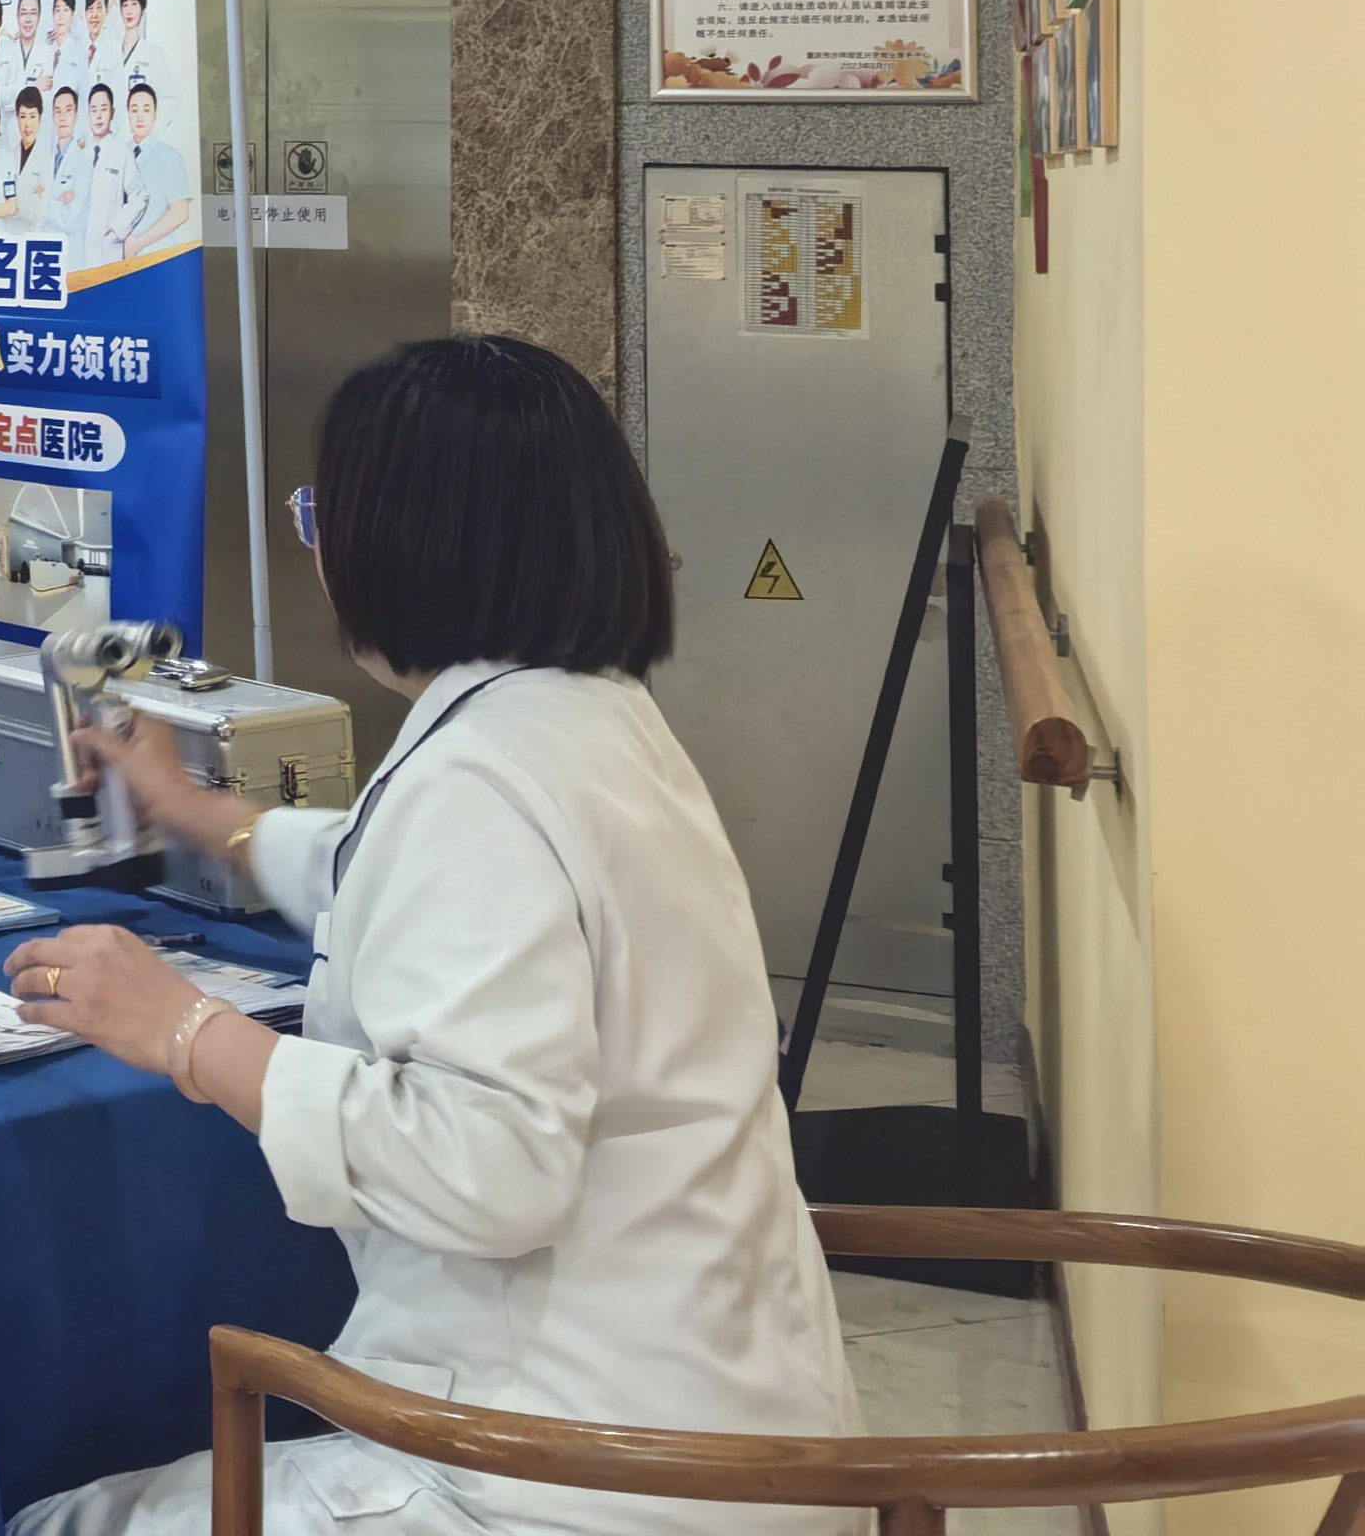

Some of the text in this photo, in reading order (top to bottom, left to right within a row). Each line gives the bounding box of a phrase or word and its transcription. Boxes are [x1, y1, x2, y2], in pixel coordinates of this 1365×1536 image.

[218, 206, 327, 223] 电已停止使用
